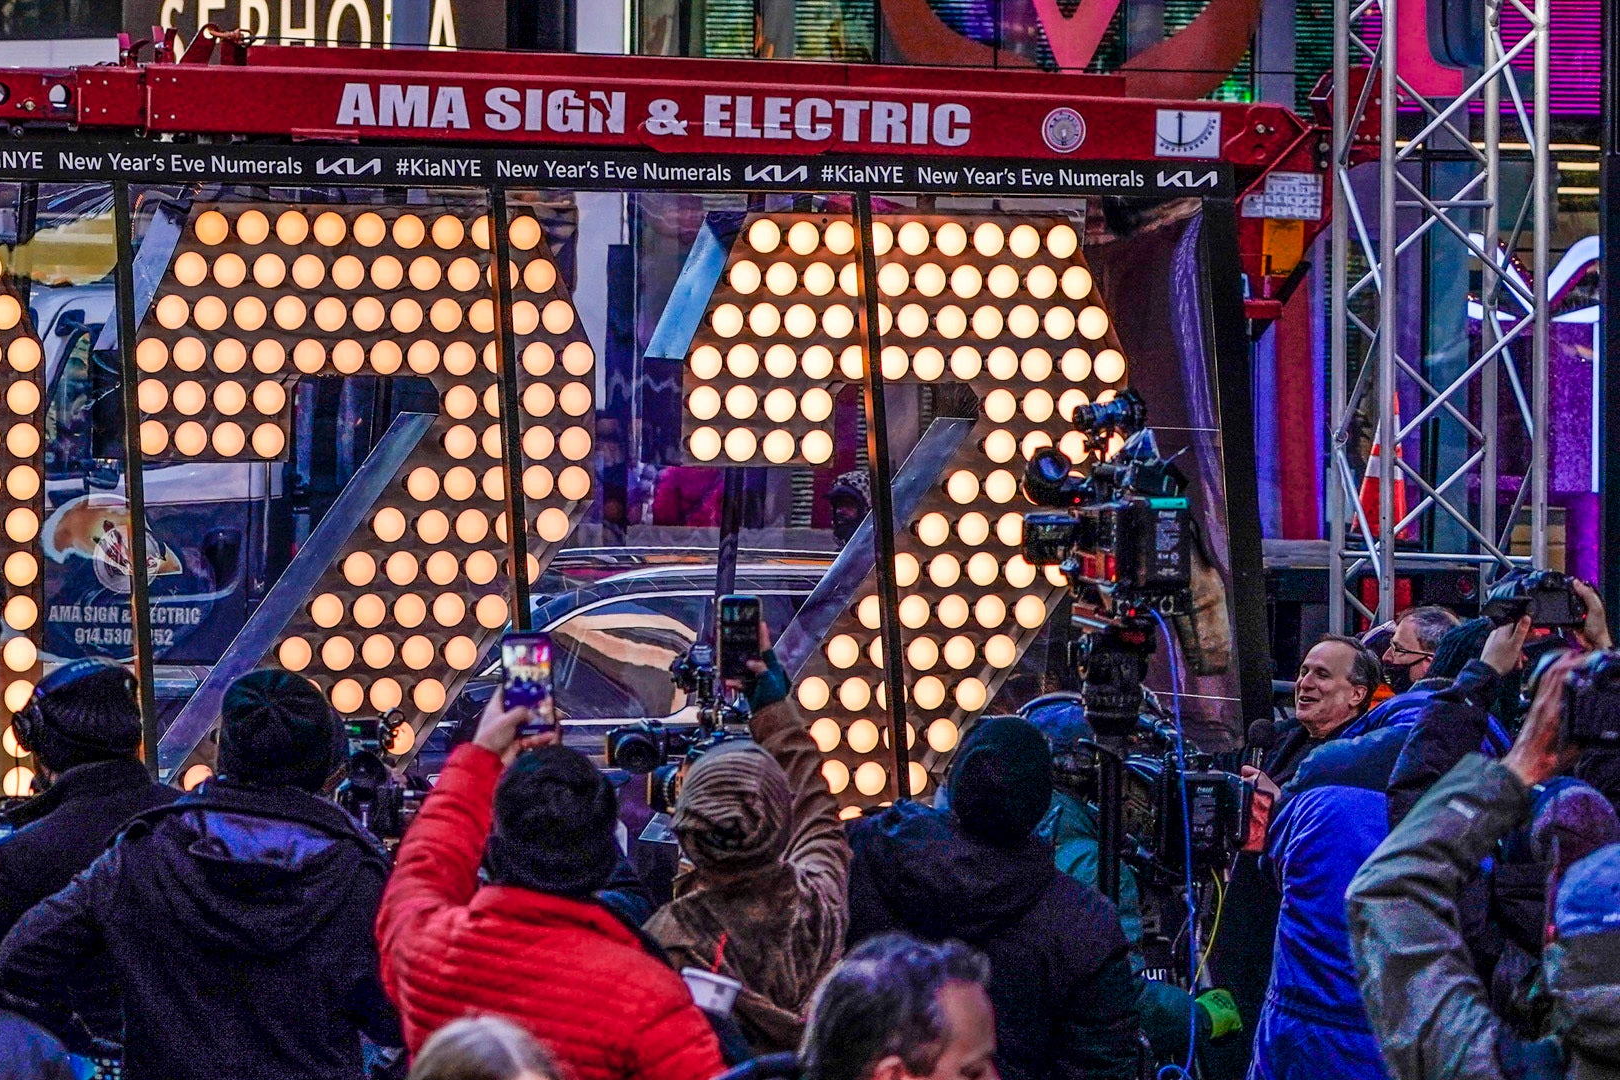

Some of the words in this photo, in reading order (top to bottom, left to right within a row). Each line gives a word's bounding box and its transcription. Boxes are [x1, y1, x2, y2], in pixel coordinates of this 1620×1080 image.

[336, 82, 471, 130] AMA
[484, 86, 627, 135] SIGN
[644, 99, 688, 137] &
[702, 94, 973, 147] ELECTRIC
[59, 152, 102, 172] New
[107, 152, 166, 173] Year's
[171, 155, 205, 173] Eve
[210, 155, 302, 175] Numerals
[396, 159, 481, 178] #KiaNYE
[497, 160, 539, 179] New
[543, 161, 599, 180] Year's
[604, 161, 638, 180] Eve
[643, 162, 732, 182] Numerals
[821, 165, 903, 184] #KiaNYE
[918, 166, 958, 186] New
[962, 167, 1016, 187] Year's
[1021, 169, 1054, 187] Eve
[1059, 169, 1144, 189] Numerals
[48, 605, 82, 623] AMA
[83, 605, 119, 624] SIGN
